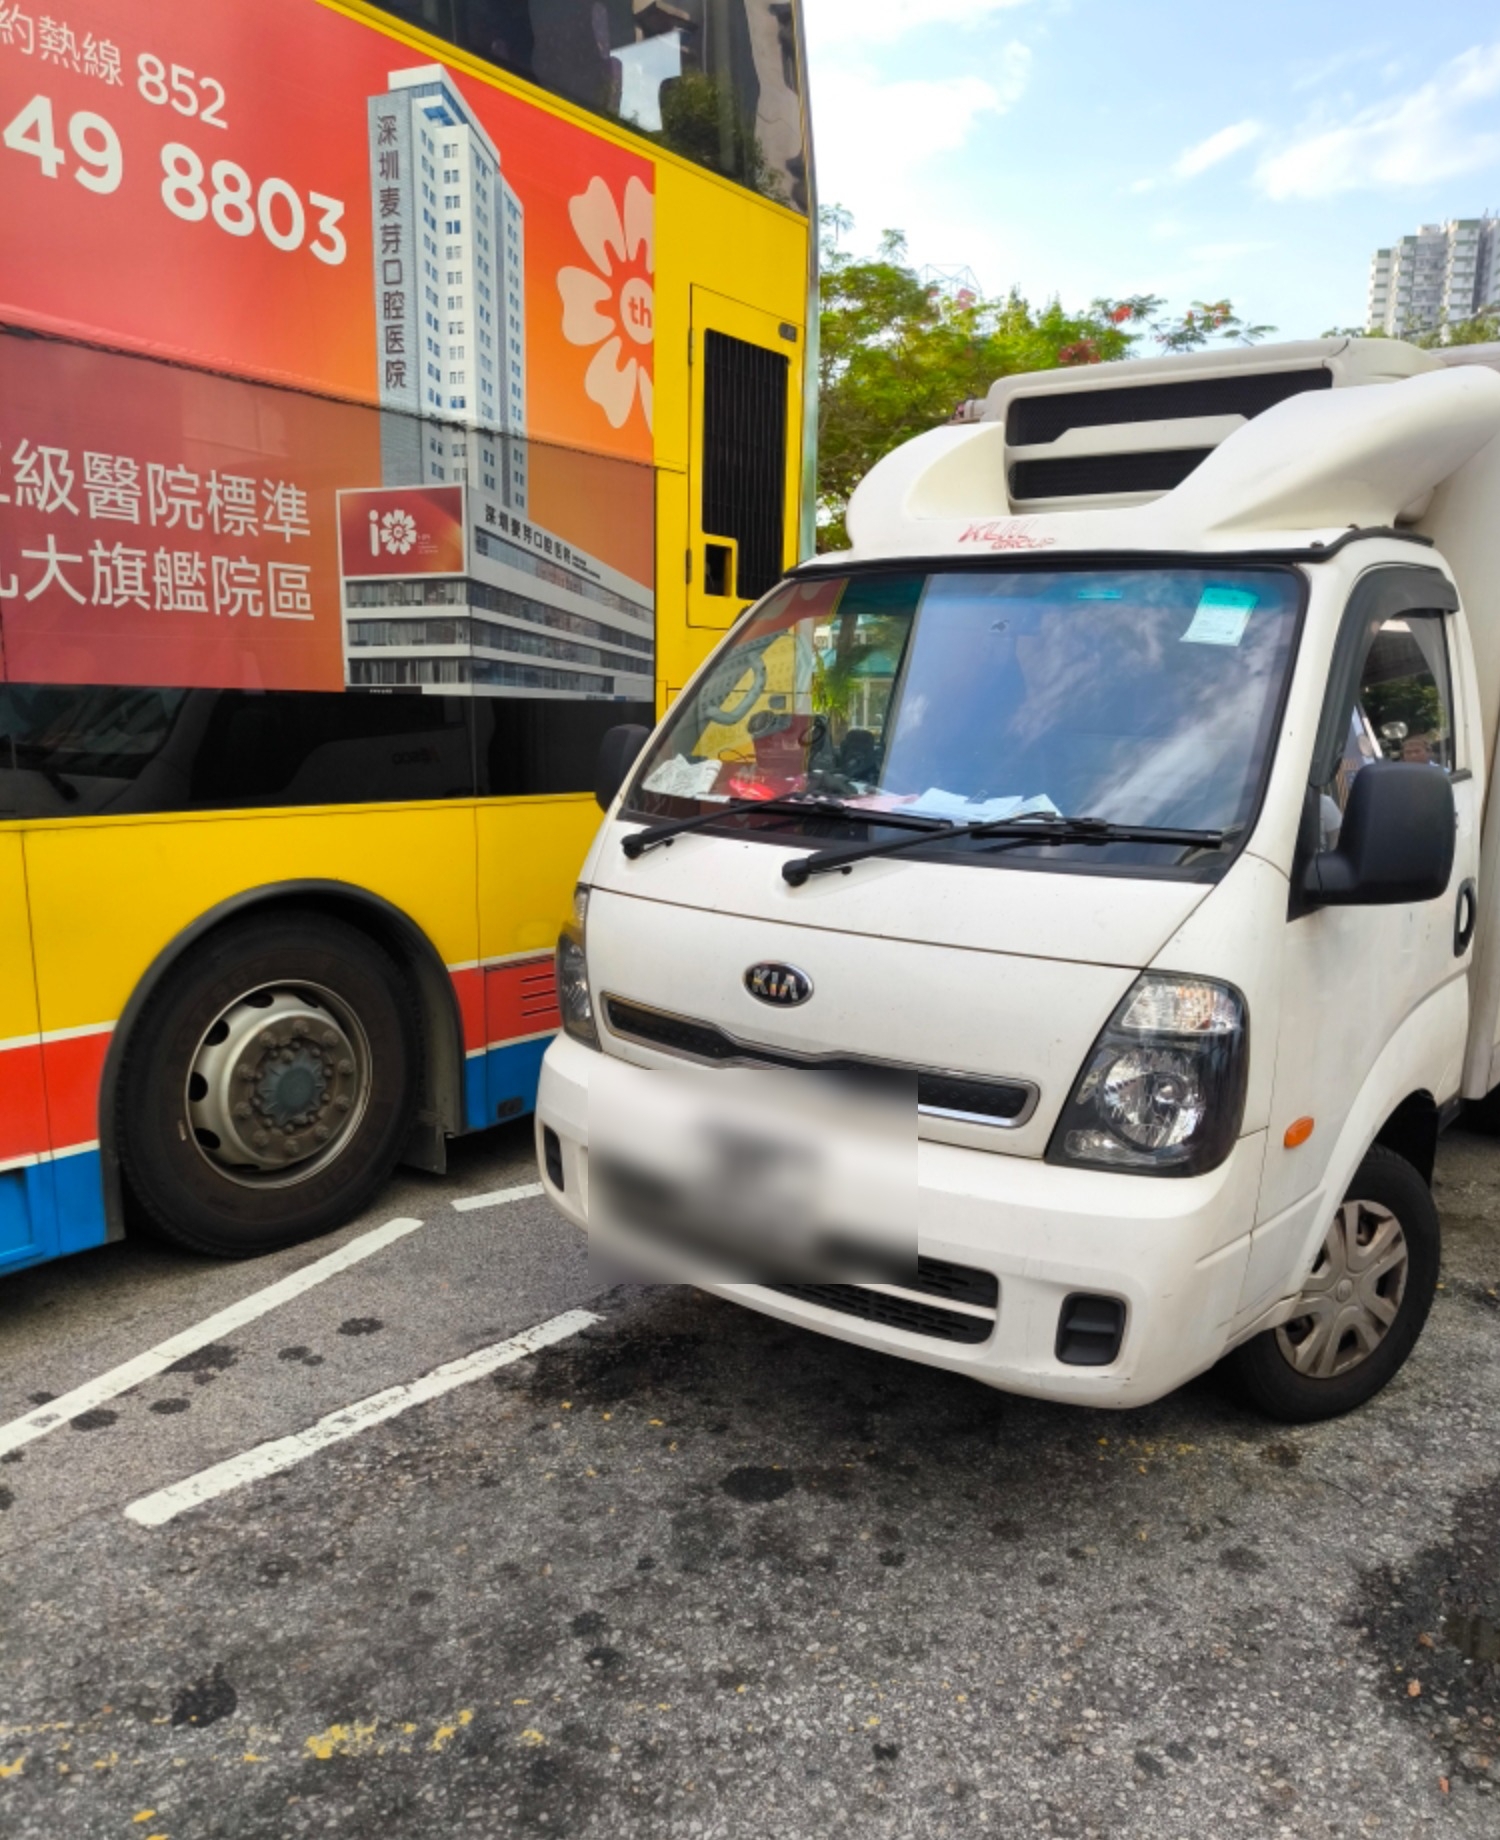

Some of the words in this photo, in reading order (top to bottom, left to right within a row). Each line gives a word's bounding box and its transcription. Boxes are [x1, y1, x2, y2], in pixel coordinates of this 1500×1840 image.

[0, 3, 124, 87] 約熱線
[137, 52, 228, 130] 852
[2, 94, 123, 194] 49
[160, 142, 347, 265] 8803
[377, 115, 407, 389] 深圳麦芽口腔医院
[628, 296, 653, 329] th
[0, 438, 311, 543] 級醫院標準
[751, 968, 799, 1000] KIA
